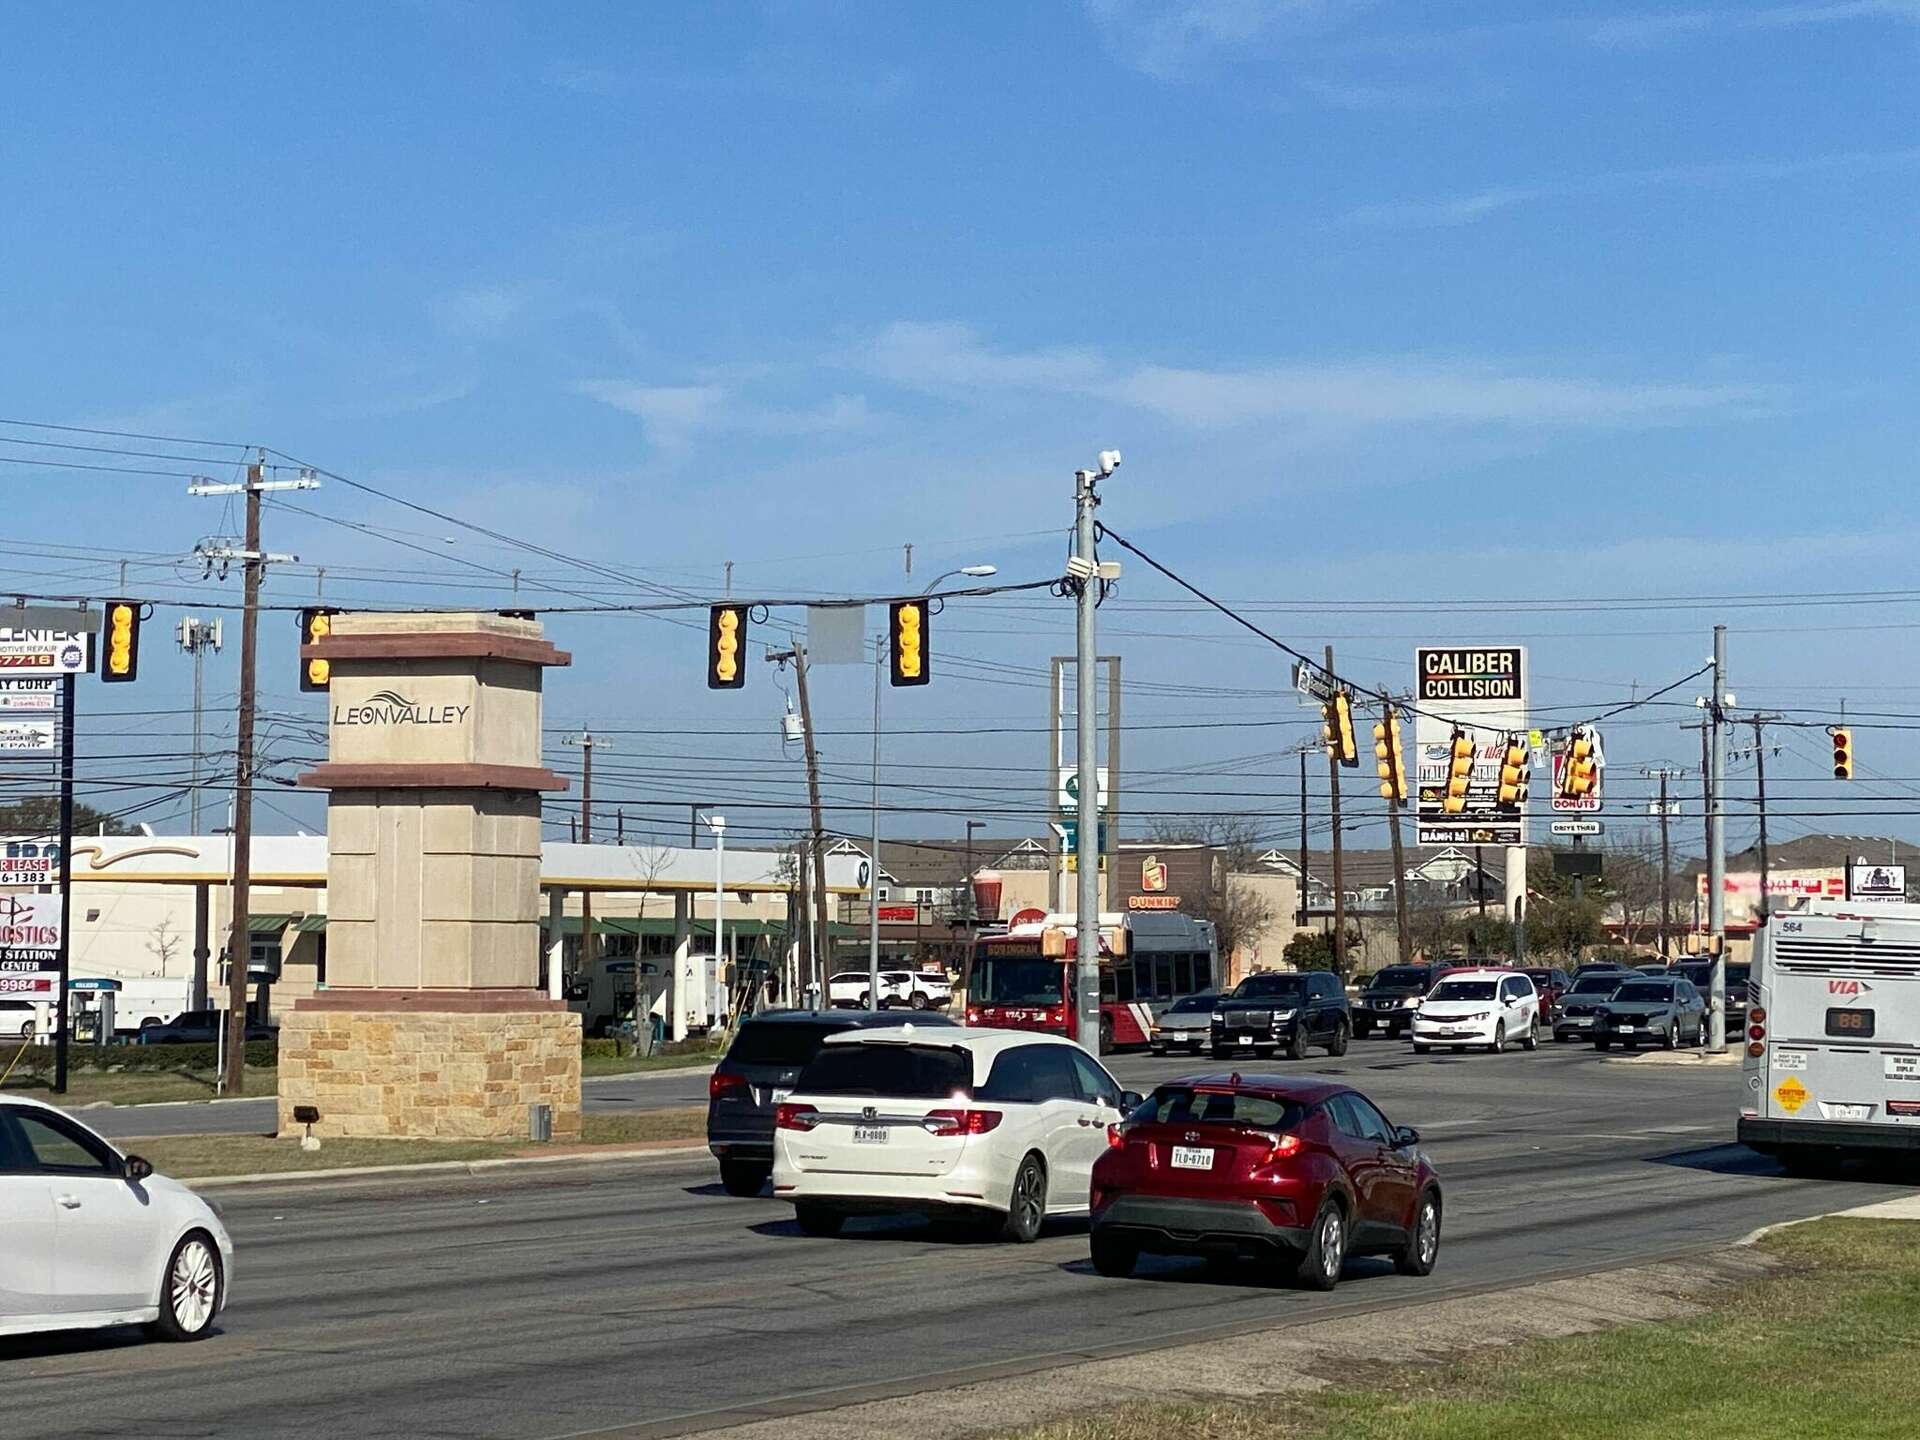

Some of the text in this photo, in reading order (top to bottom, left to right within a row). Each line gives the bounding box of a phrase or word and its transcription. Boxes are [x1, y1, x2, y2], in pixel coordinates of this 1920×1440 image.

[1426, 653, 1513, 673] CALIBER
[18, 679, 52, 690] CORP
[1426, 680, 1514, 697] COLLISION
[1554, 800, 1595, 808] DONUTS
[12, 860, 46, 870] LEASE
[1783, 922, 1802, 934] 564
[5, 951, 56, 960] STATION
[1, 961, 39, 971] CENTER
[1829, 981, 1858, 994] VIA
